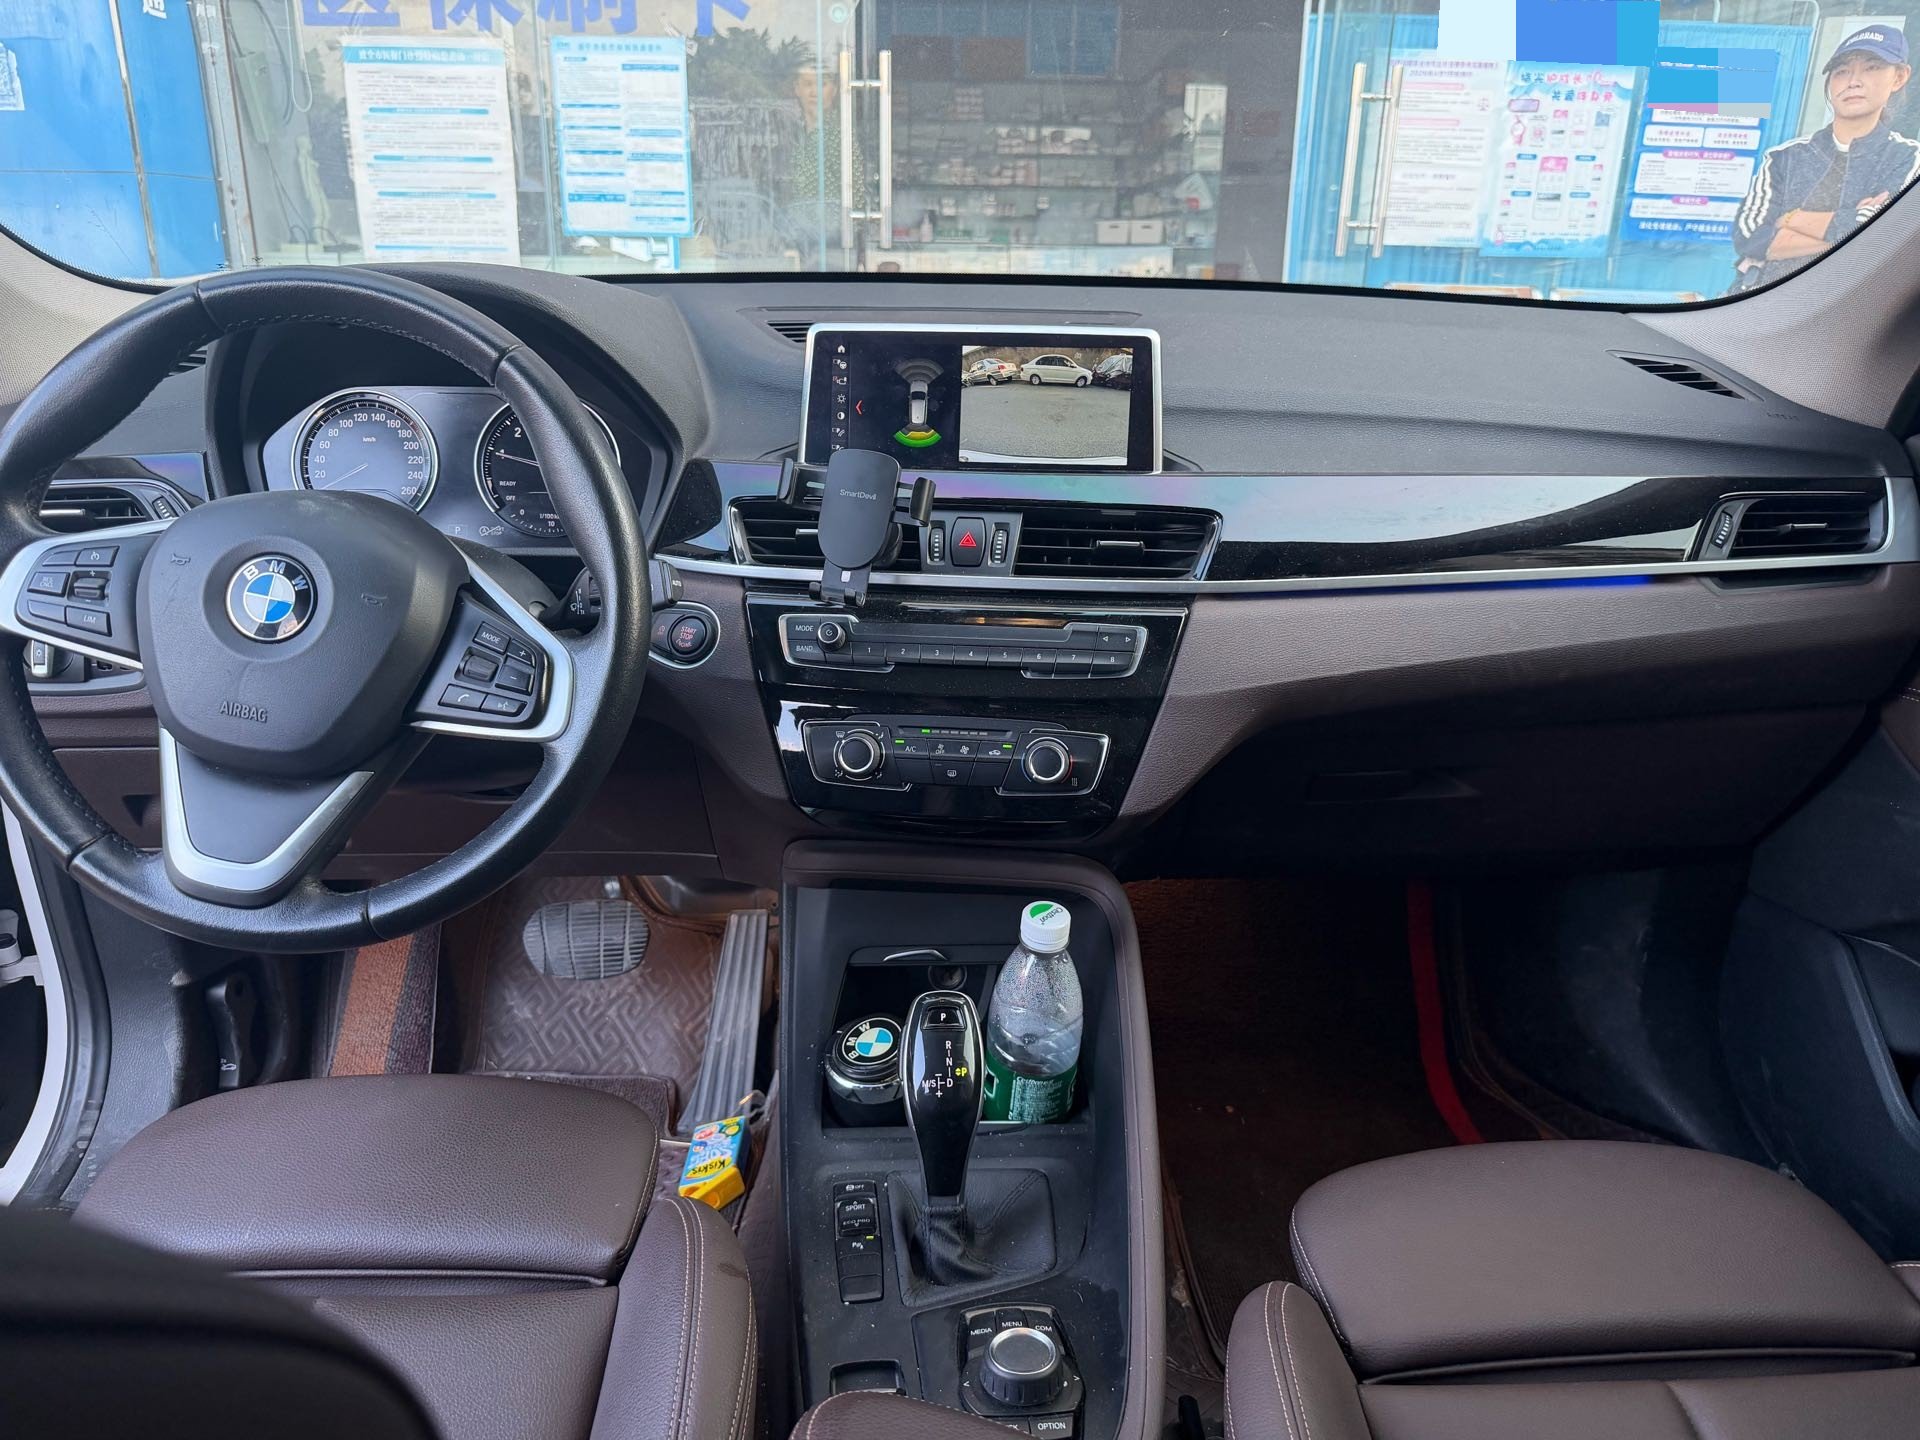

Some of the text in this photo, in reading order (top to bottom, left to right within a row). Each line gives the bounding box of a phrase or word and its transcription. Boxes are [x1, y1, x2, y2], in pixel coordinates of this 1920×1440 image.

[353, 413, 368, 422] 120
[371, 413, 386, 421] 140
[339, 419, 353, 428] 100
[386, 420, 401, 428] 160
[328, 428, 339, 437] 80
[397, 430, 412, 438] 180
[514, 427, 522, 438] 2
[319, 440, 330, 449] 60
[403, 442, 419, 450] 200
[407, 456, 423, 464] 220
[314, 470, 326, 478] 20
[407, 471, 423, 480] 240
[401, 486, 417, 495] 260
[243, 560, 308, 591] BMW
[83, 615, 97, 624] LIM
[681, 626, 697, 634] START
[481, 632, 501, 644] MODE
[680, 632, 693, 640] STOP
[220, 701, 267, 723] AIRBAG
[940, 1013, 946, 1021] P
[945, 1041, 952, 1050] R
[945, 1058, 953, 1066] N
[961, 1067, 968, 1077] P
[921, 1080, 936, 1088] M/S
[946, 1078, 953, 1087] D
[845, 1203, 865, 1212] SPORT
[970, 1327, 992, 1336] MEDIA
[1037, 1422, 1066, 1431] OPTION
